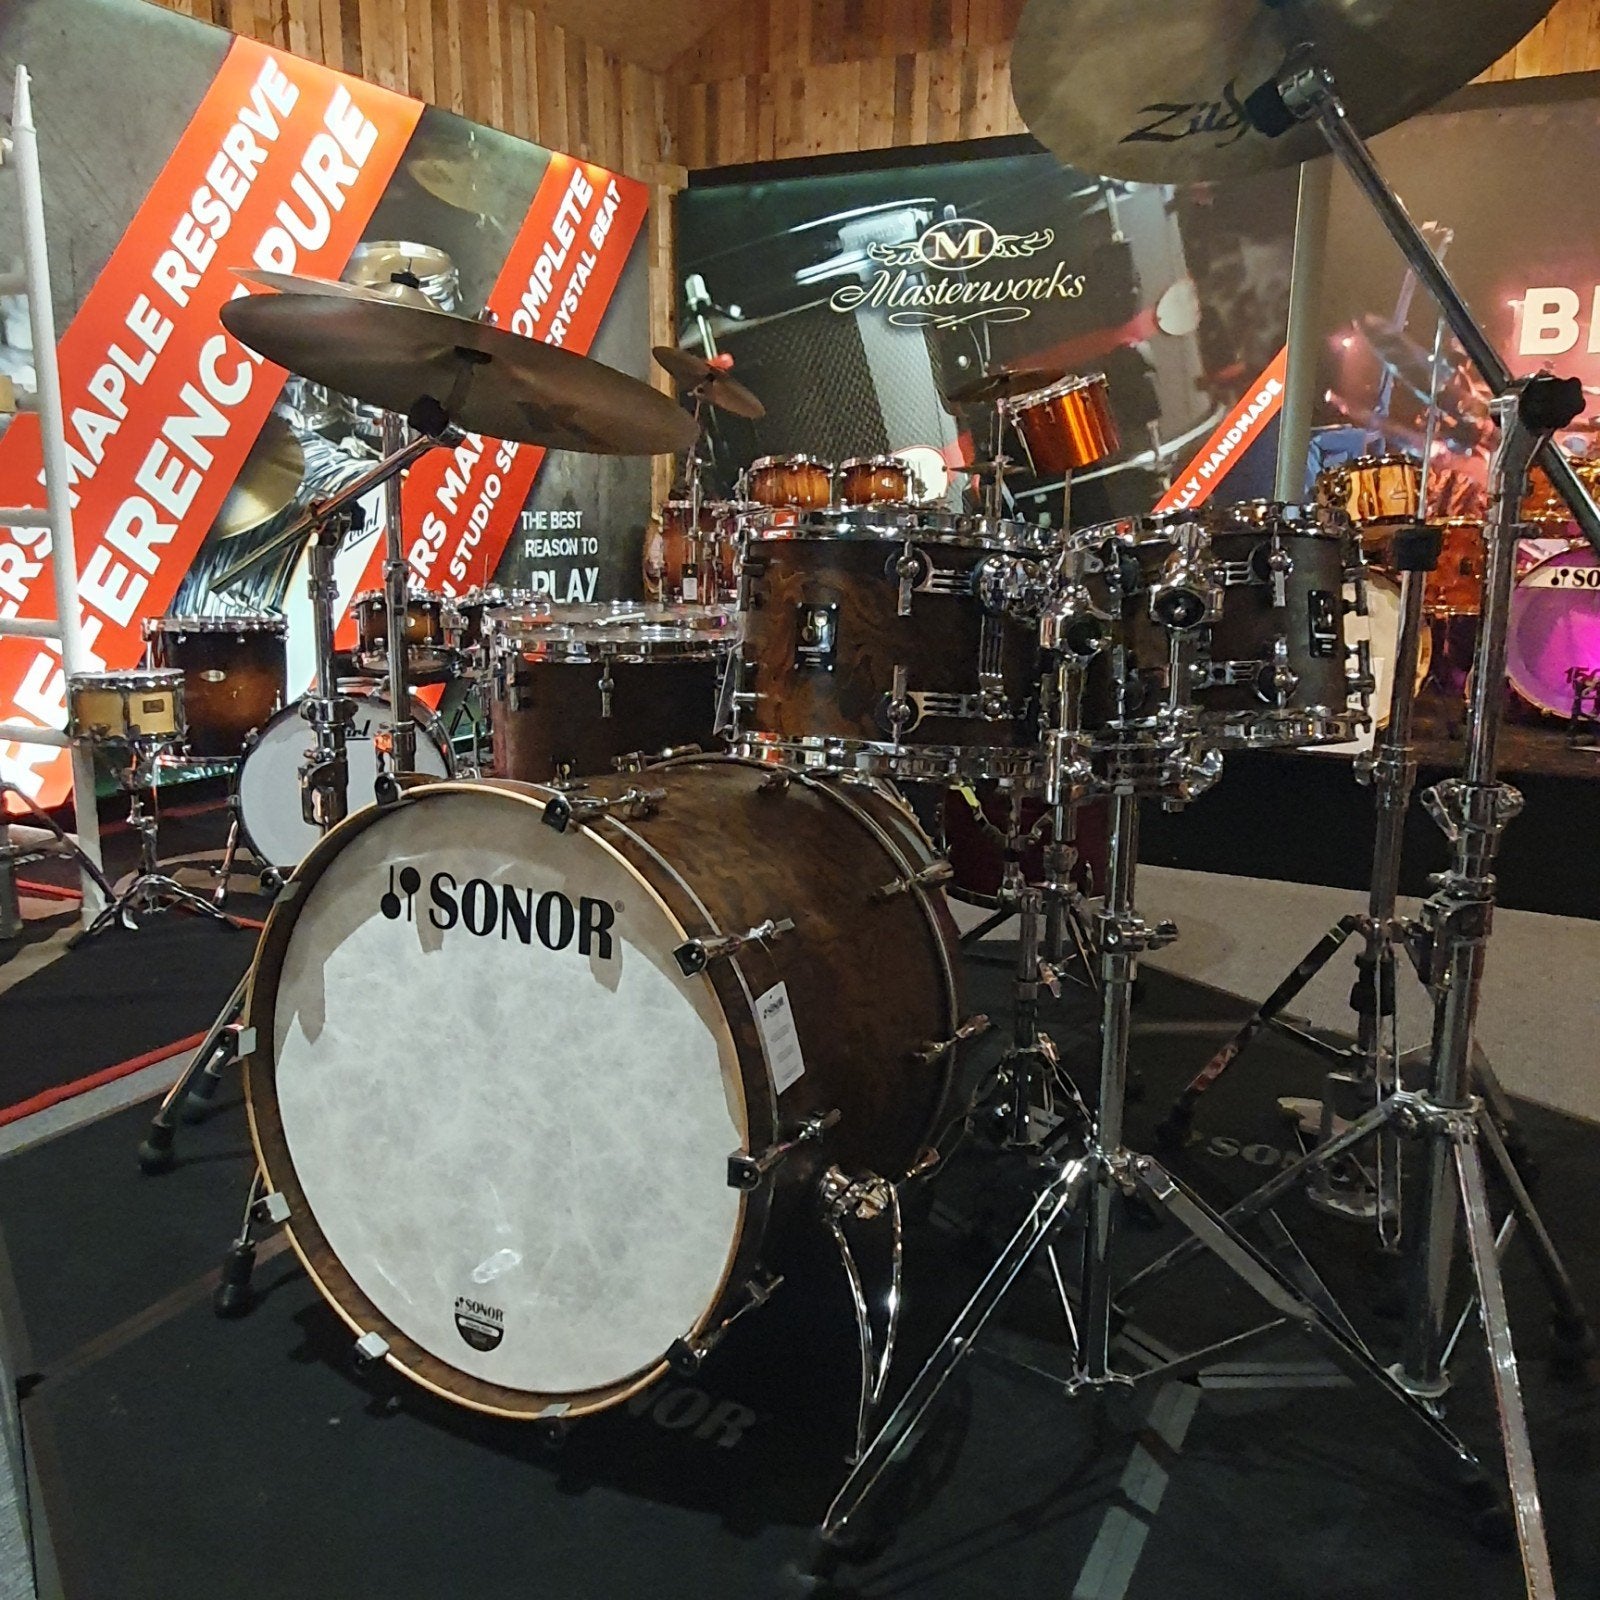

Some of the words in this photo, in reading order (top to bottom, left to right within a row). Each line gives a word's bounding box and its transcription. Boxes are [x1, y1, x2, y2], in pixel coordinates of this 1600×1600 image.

[152, 56, 300, 308] RESERVE
[252, 84, 379, 275] PURE
[511, 167, 594, 338] OMPLETE
[830, 261, 1086, 313] Masterworks
[450, 474, 501, 582] STUDIO
[589, 179, 621, 251] BEAT
[1198, 378, 1283, 479] HANDMADE
[521, 511, 548, 531] THE
[550, 511, 583, 530] BEST
[525, 538, 578, 558] REASON
[581, 537, 599, 555] TO
[531, 566, 600, 604] PLAY
[429, 872, 615, 960] SONOR
[465, 1298, 503, 1322] SONOR
